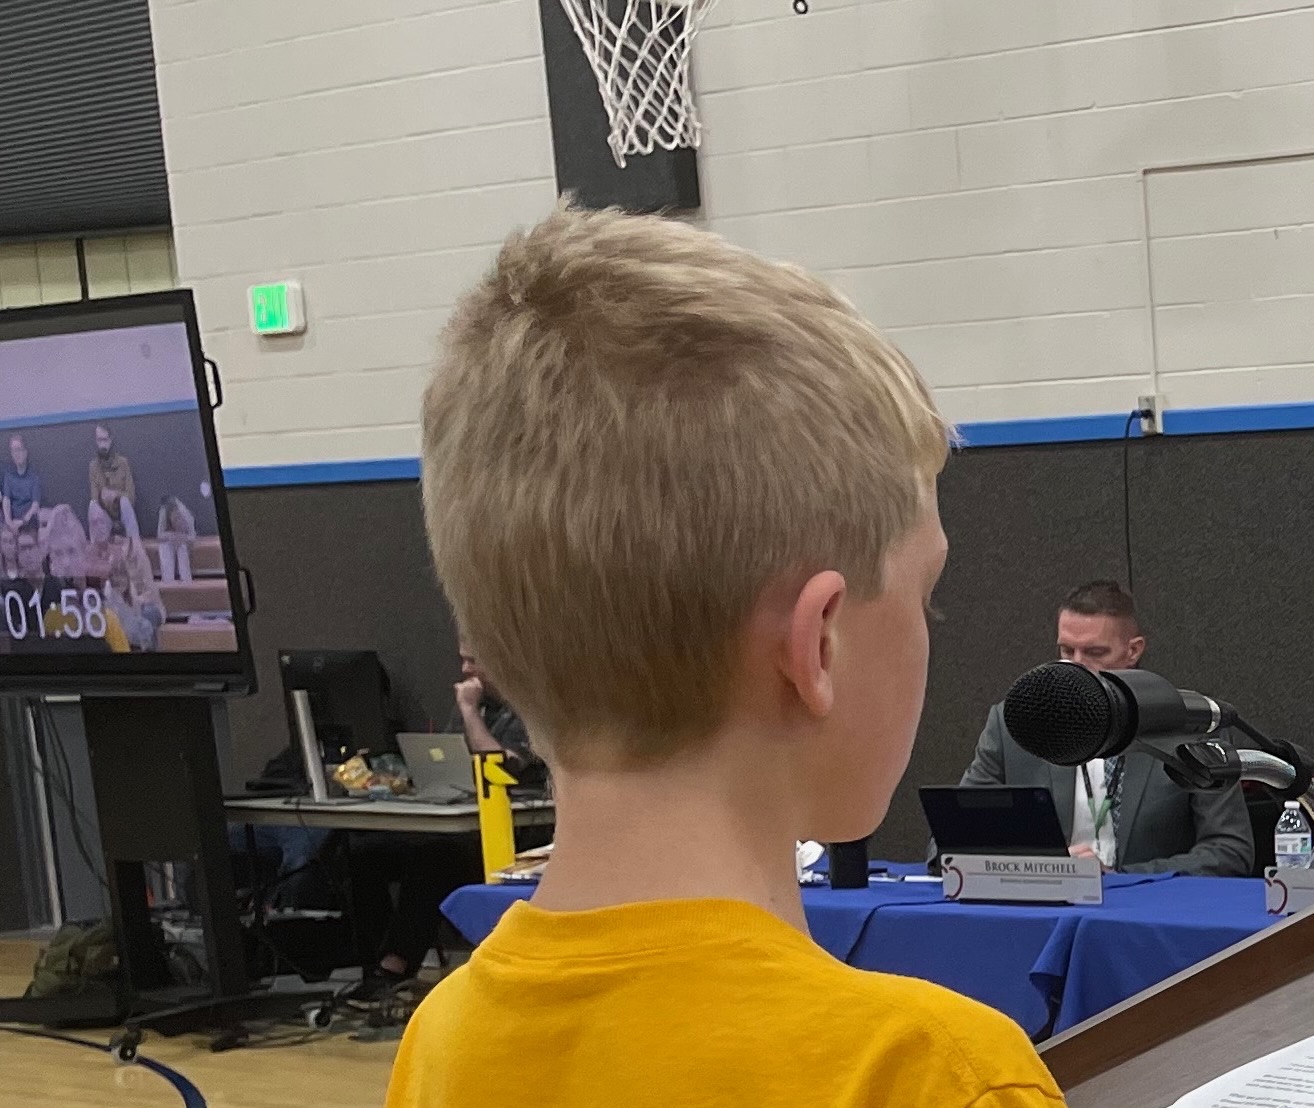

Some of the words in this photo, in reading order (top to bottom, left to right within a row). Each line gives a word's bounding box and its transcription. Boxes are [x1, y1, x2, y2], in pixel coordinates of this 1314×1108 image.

[5, 588, 107, 640] 01:58
[985, 860, 1020, 872] BROCK
[1023, 862, 1076, 874] MITCHELL
